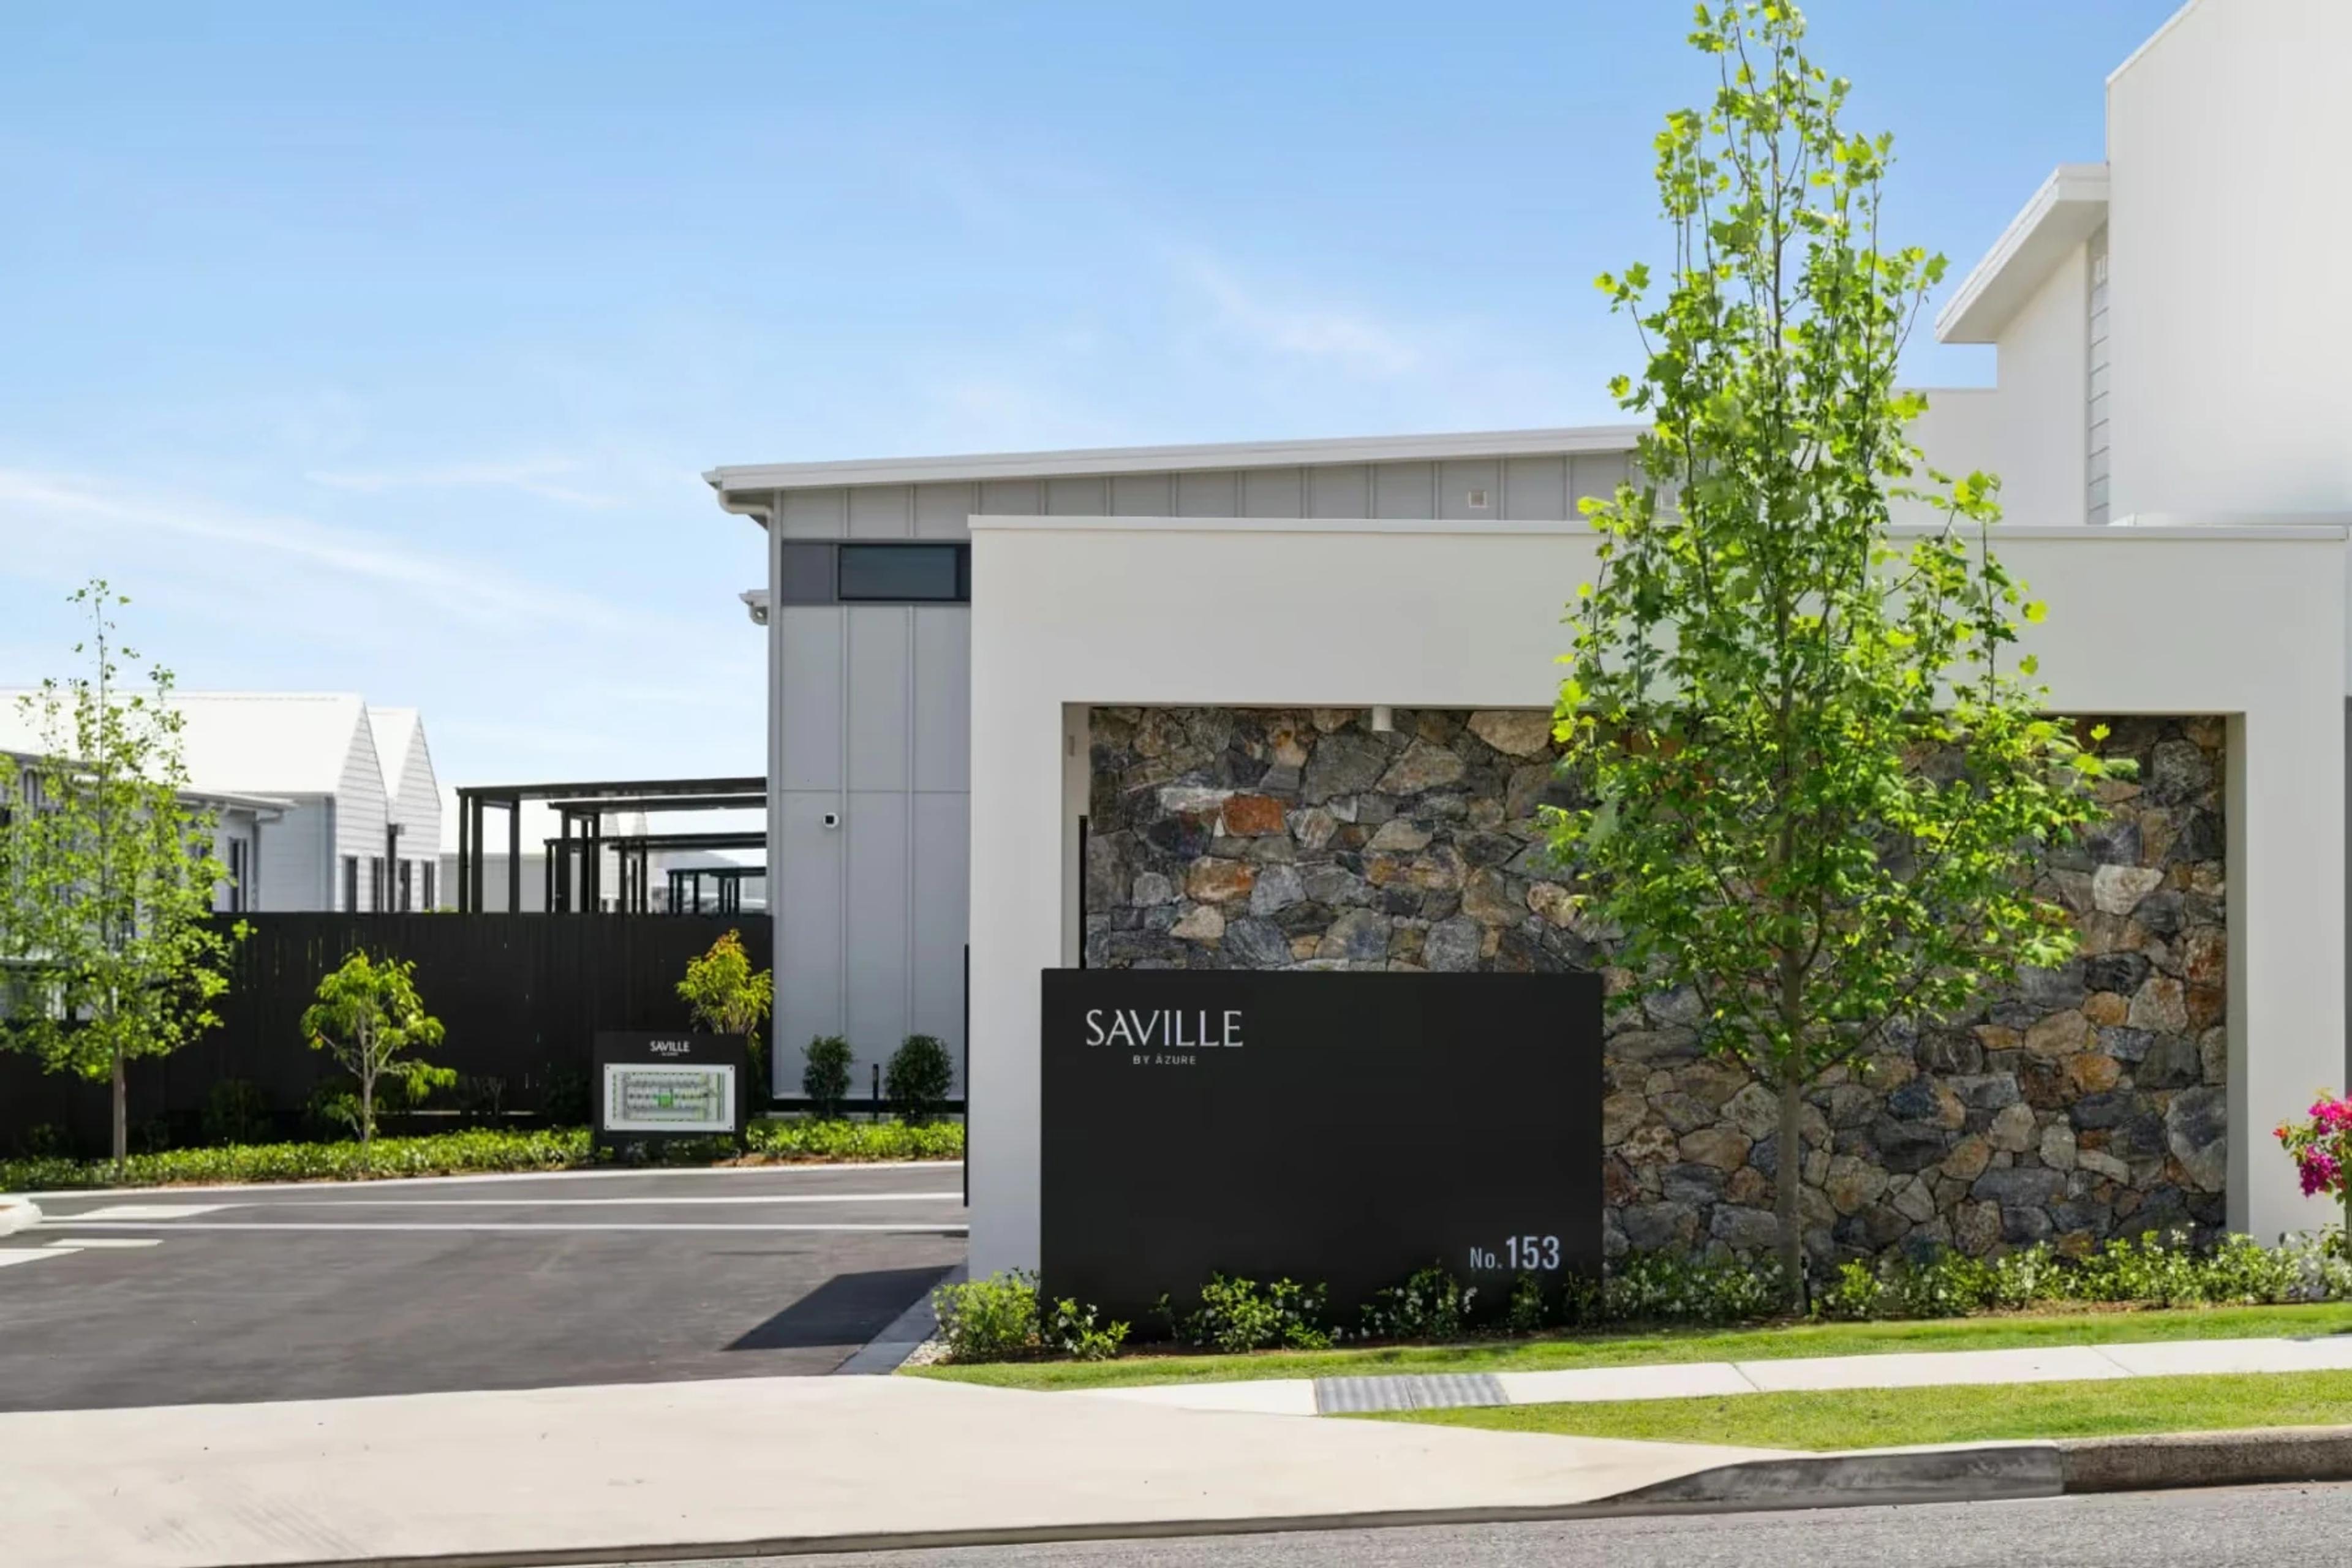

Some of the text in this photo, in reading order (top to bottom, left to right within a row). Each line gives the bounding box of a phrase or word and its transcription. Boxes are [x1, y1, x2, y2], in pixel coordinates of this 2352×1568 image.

[1086, 1009, 1244, 1046] SAVILLE
[649, 1040, 690, 1052] SAVILLE
[1133, 1055, 1150, 1065] BY
